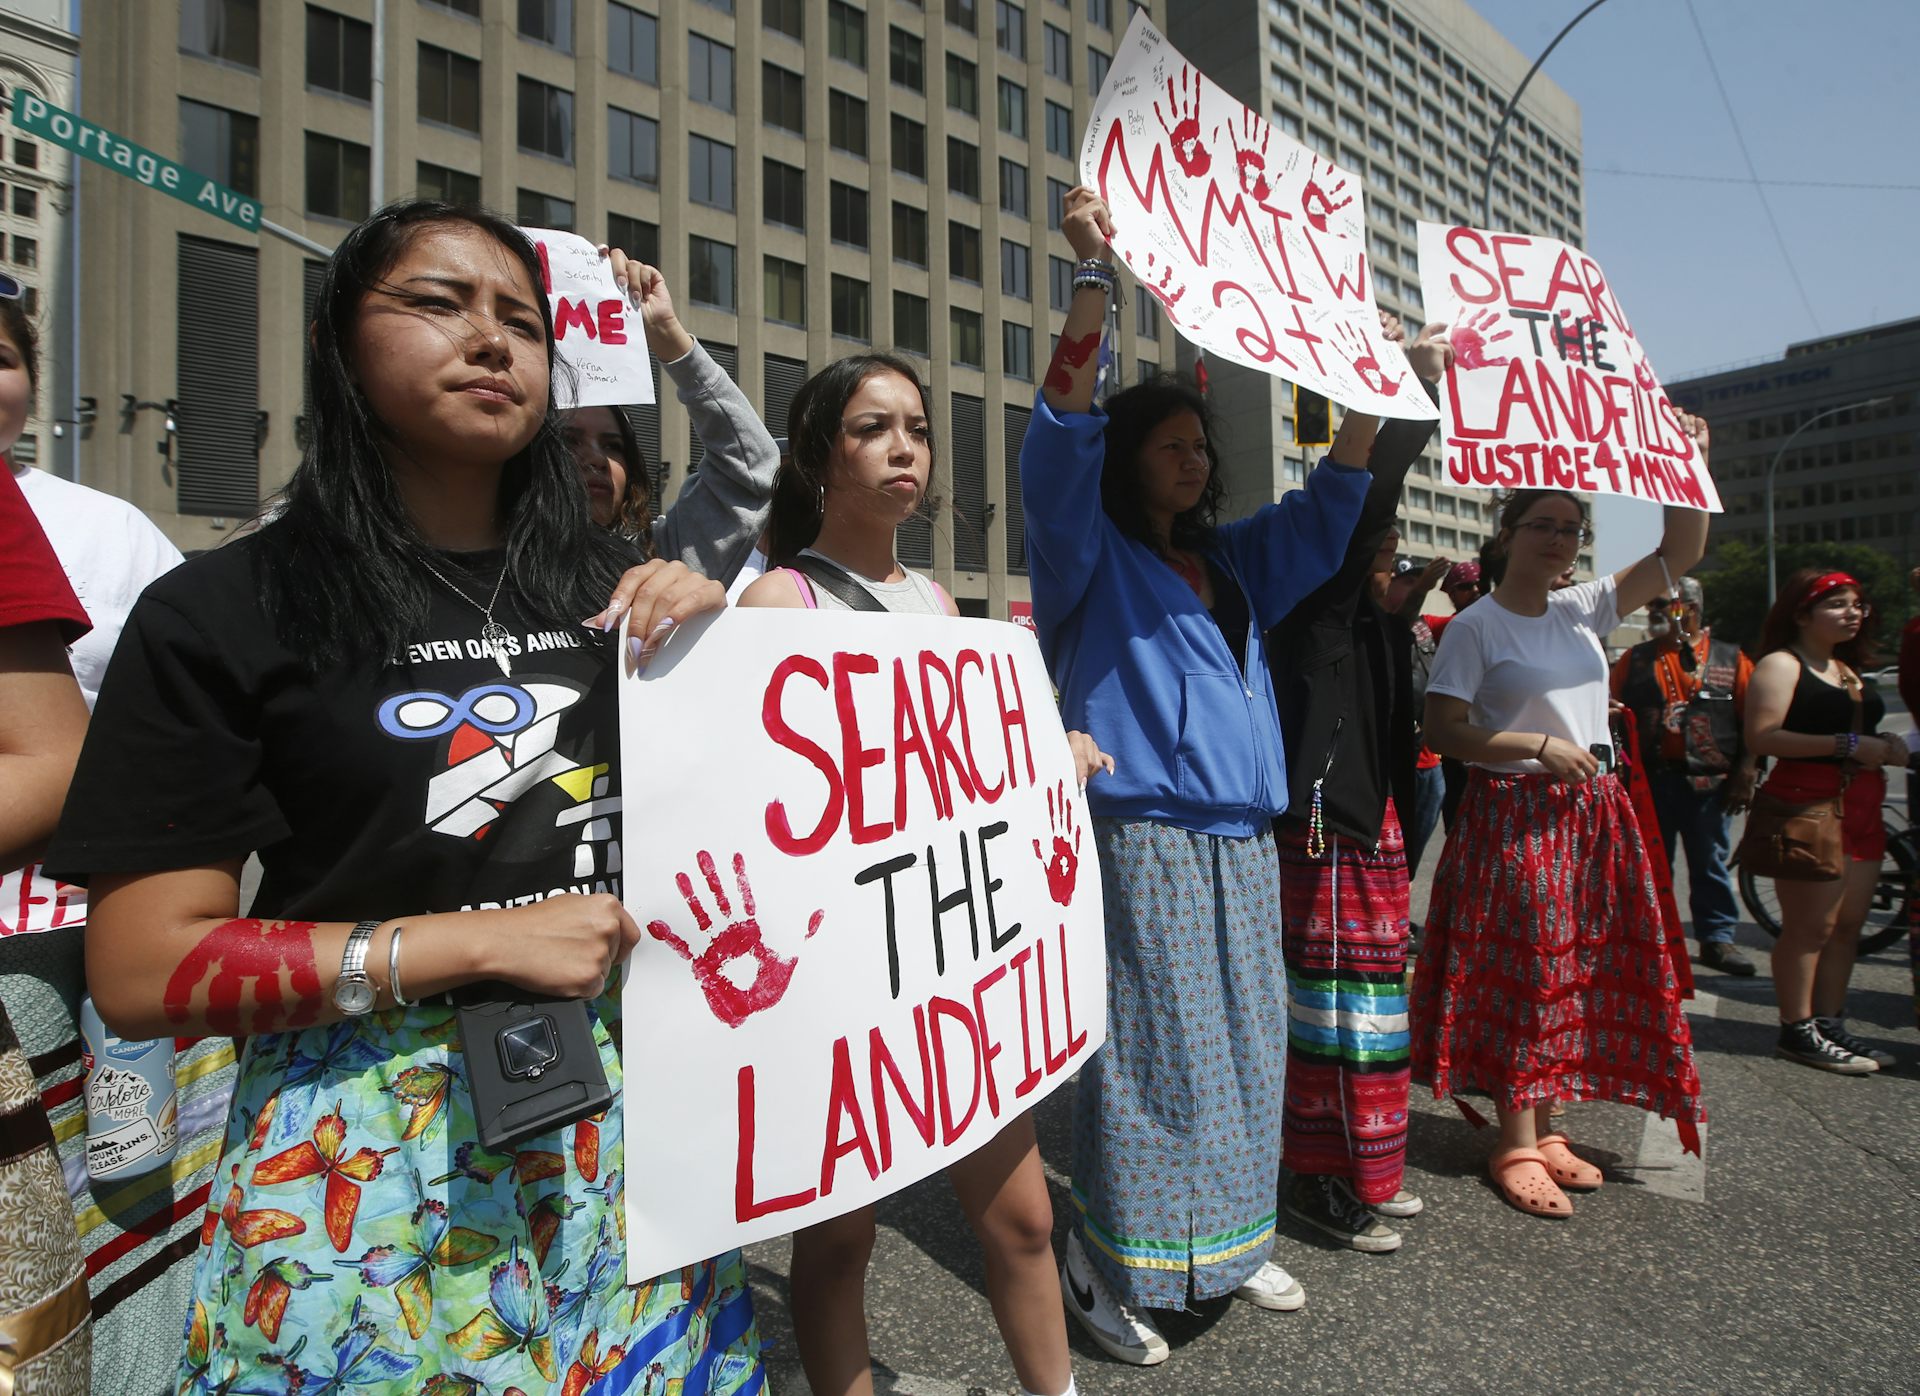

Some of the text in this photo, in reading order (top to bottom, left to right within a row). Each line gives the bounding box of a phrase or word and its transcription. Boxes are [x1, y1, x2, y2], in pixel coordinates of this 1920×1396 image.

[22, 95, 257, 223] Portage Ave
[1098, 117, 1366, 303] MMIW
[554, 296, 628, 345] ME
[1446, 226, 1634, 339] SEAR
[1508, 308, 1617, 373] THE
[1445, 356, 1695, 462] LANDFILLS
[1447, 437, 1599, 491] JUSTICE
[393, 638, 464, 666] EVEN
[1012, 614, 1032, 626] CIBC
[761, 649, 1036, 857] SEARCH
[855, 821, 1022, 999] THE
[114, 1103, 146, 1121] MORE
[735, 922, 1088, 1223] LANDFILL
